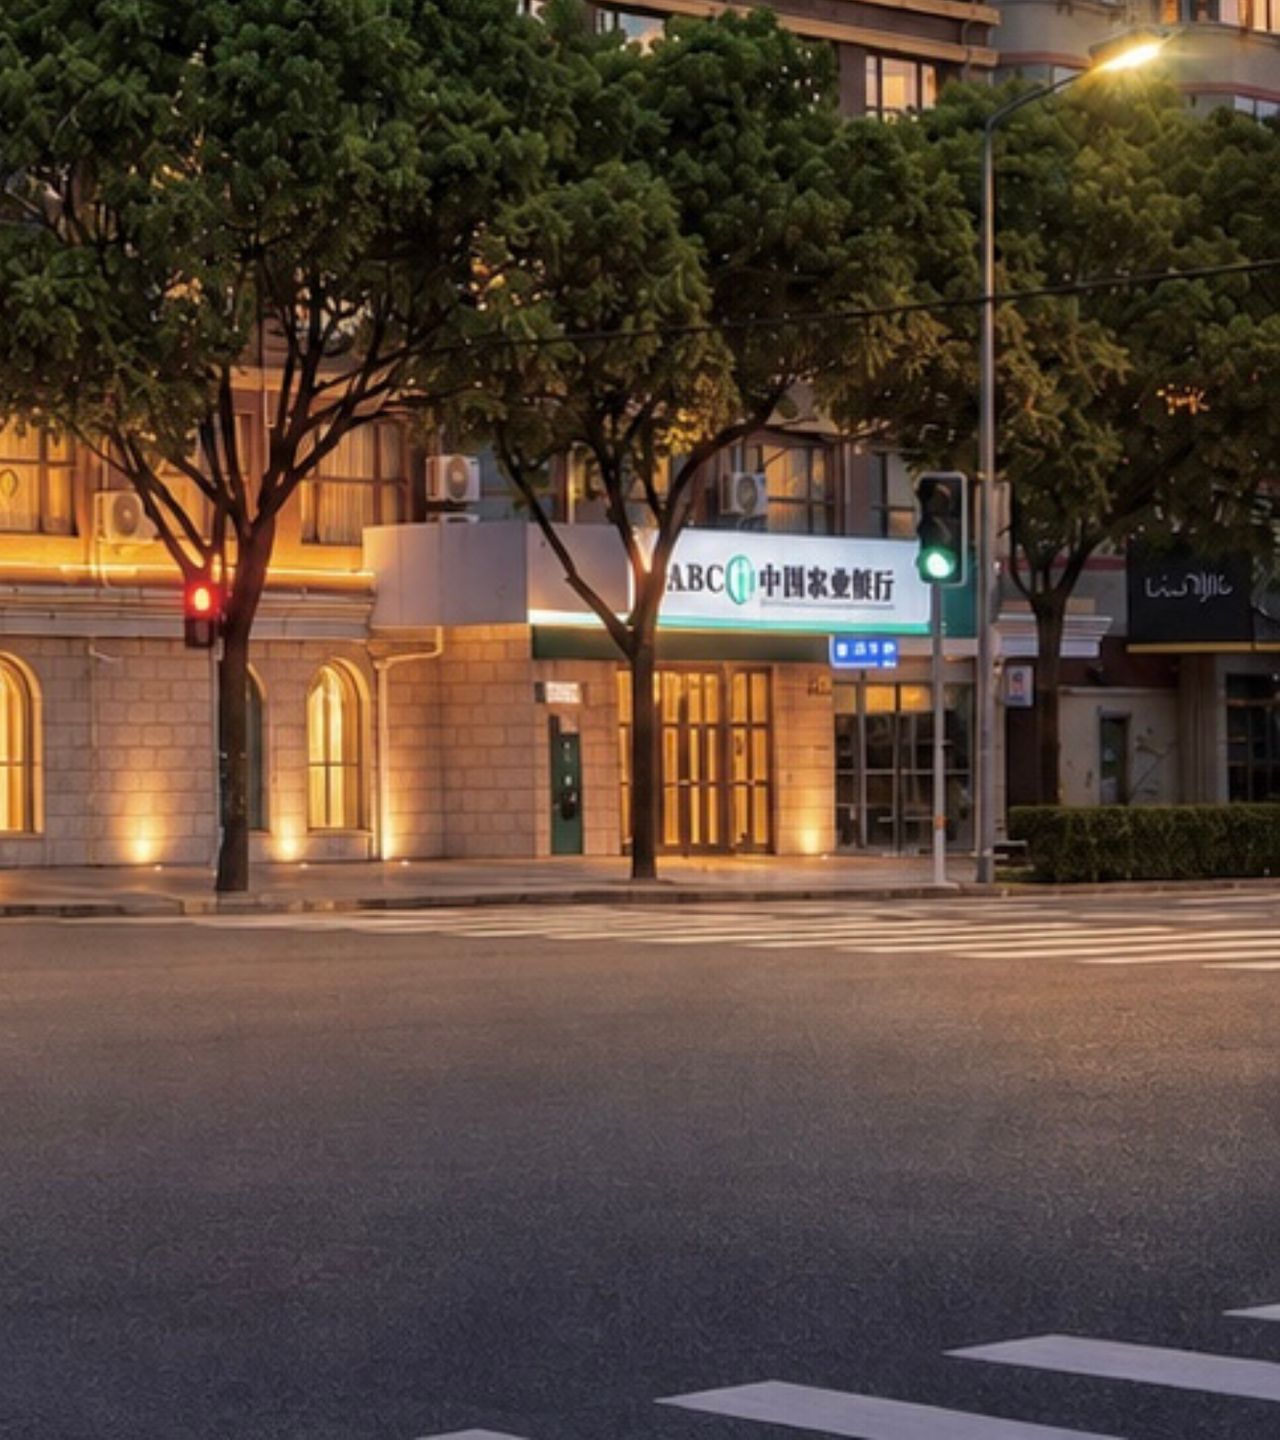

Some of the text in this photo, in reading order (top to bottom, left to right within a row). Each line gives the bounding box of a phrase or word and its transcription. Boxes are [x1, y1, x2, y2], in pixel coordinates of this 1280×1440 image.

[667, 563, 724, 593] ABC
[759, 563, 894, 601] 中国农业银行
